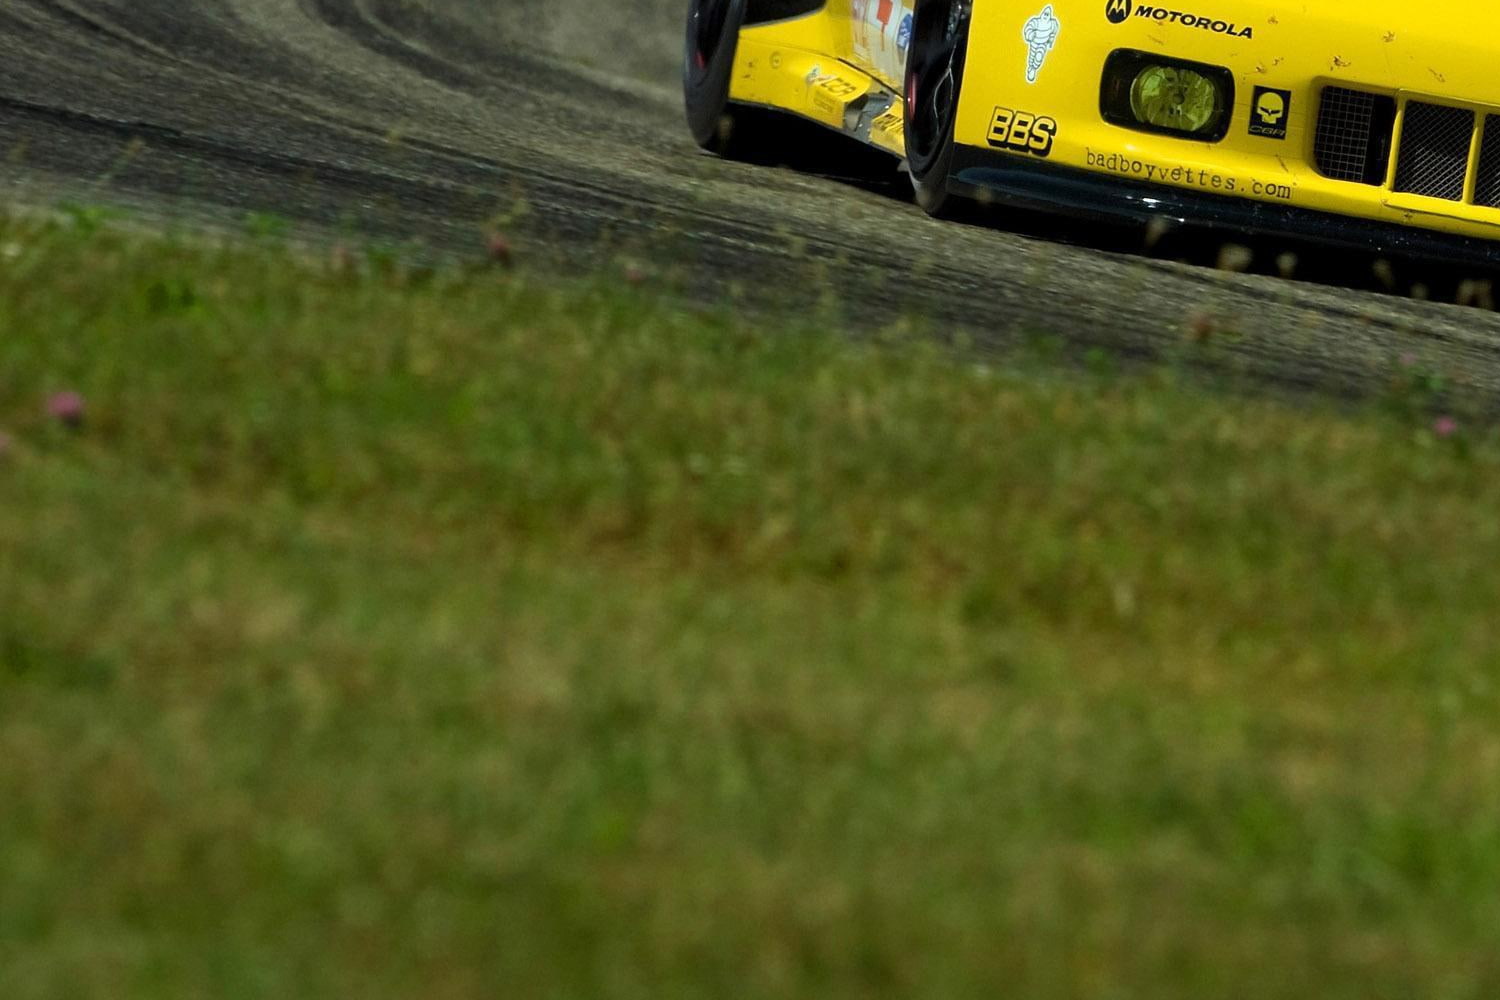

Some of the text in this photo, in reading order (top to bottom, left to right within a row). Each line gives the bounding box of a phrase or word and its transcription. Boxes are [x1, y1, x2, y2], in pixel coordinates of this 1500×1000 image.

[1133, 4, 1254, 40] MOTOROLA
[986, 105, 1058, 158] BBS
[1086, 147, 1292, 200] badboyvettes.com
